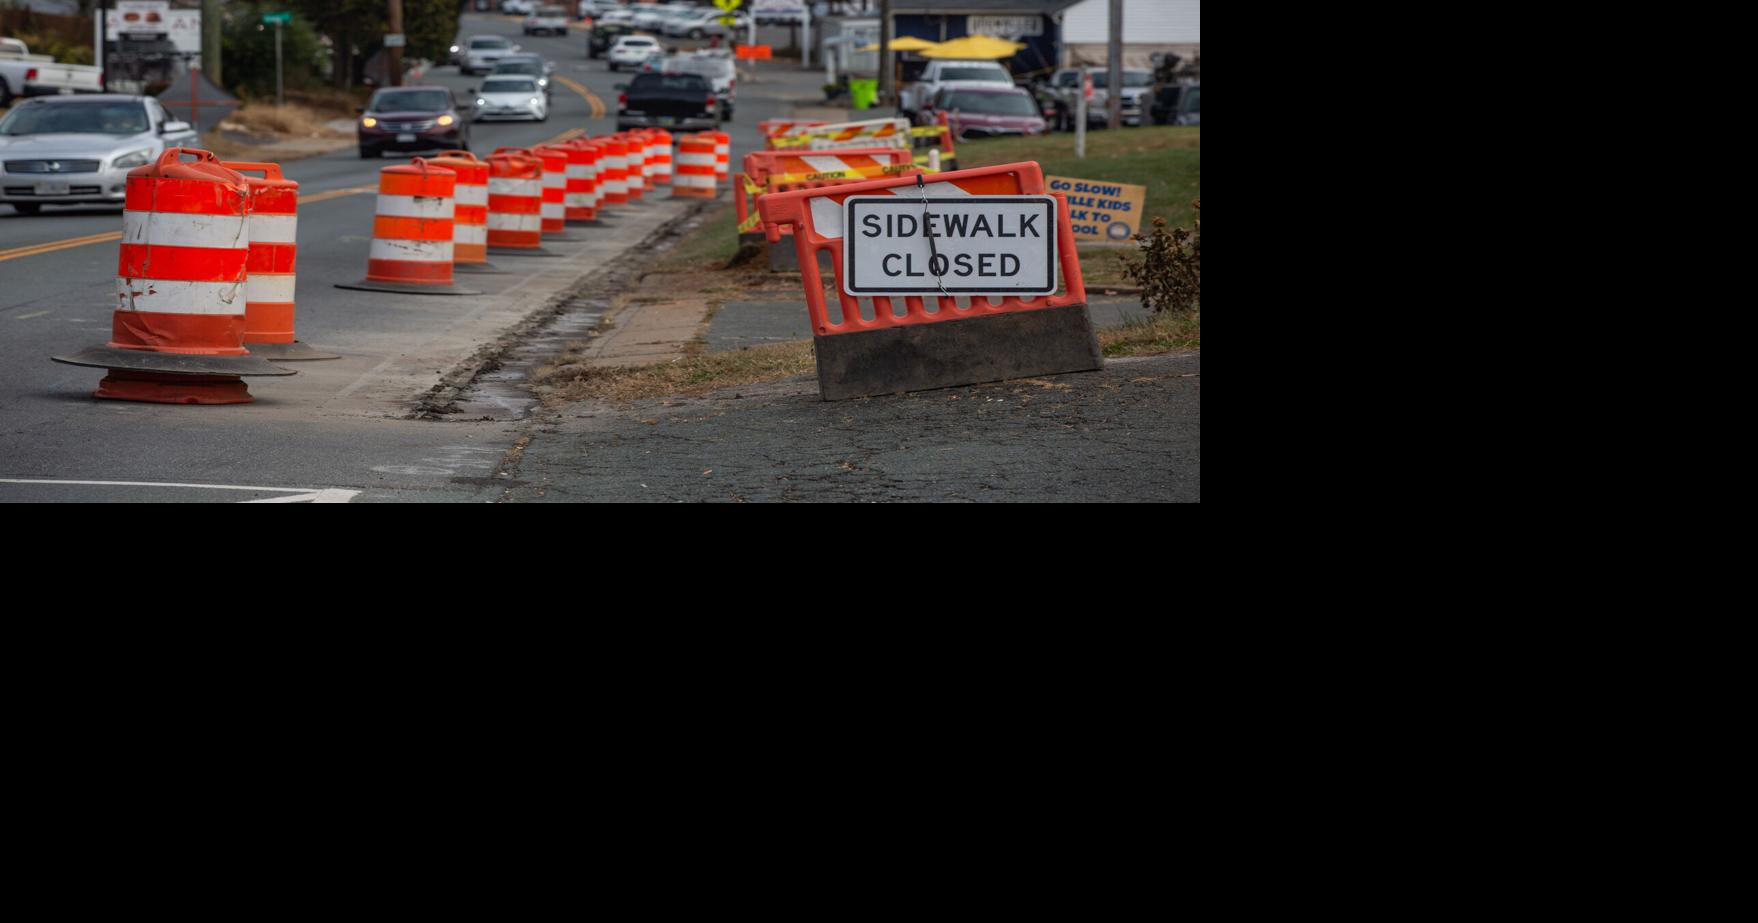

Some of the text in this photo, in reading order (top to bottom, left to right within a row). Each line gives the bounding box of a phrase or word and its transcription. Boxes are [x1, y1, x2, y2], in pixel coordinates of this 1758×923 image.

[806, 171, 845, 181] CAUTION
[1050, 180, 1121, 197] GO SLOW!
[1067, 195, 1132, 212] ILLE KIDS
[1071, 209, 1111, 222] LK TO
[862, 213, 1040, 238] SIDEWALK
[1071, 224, 1099, 235] OOL
[882, 253, 1021, 277] CLOSED
